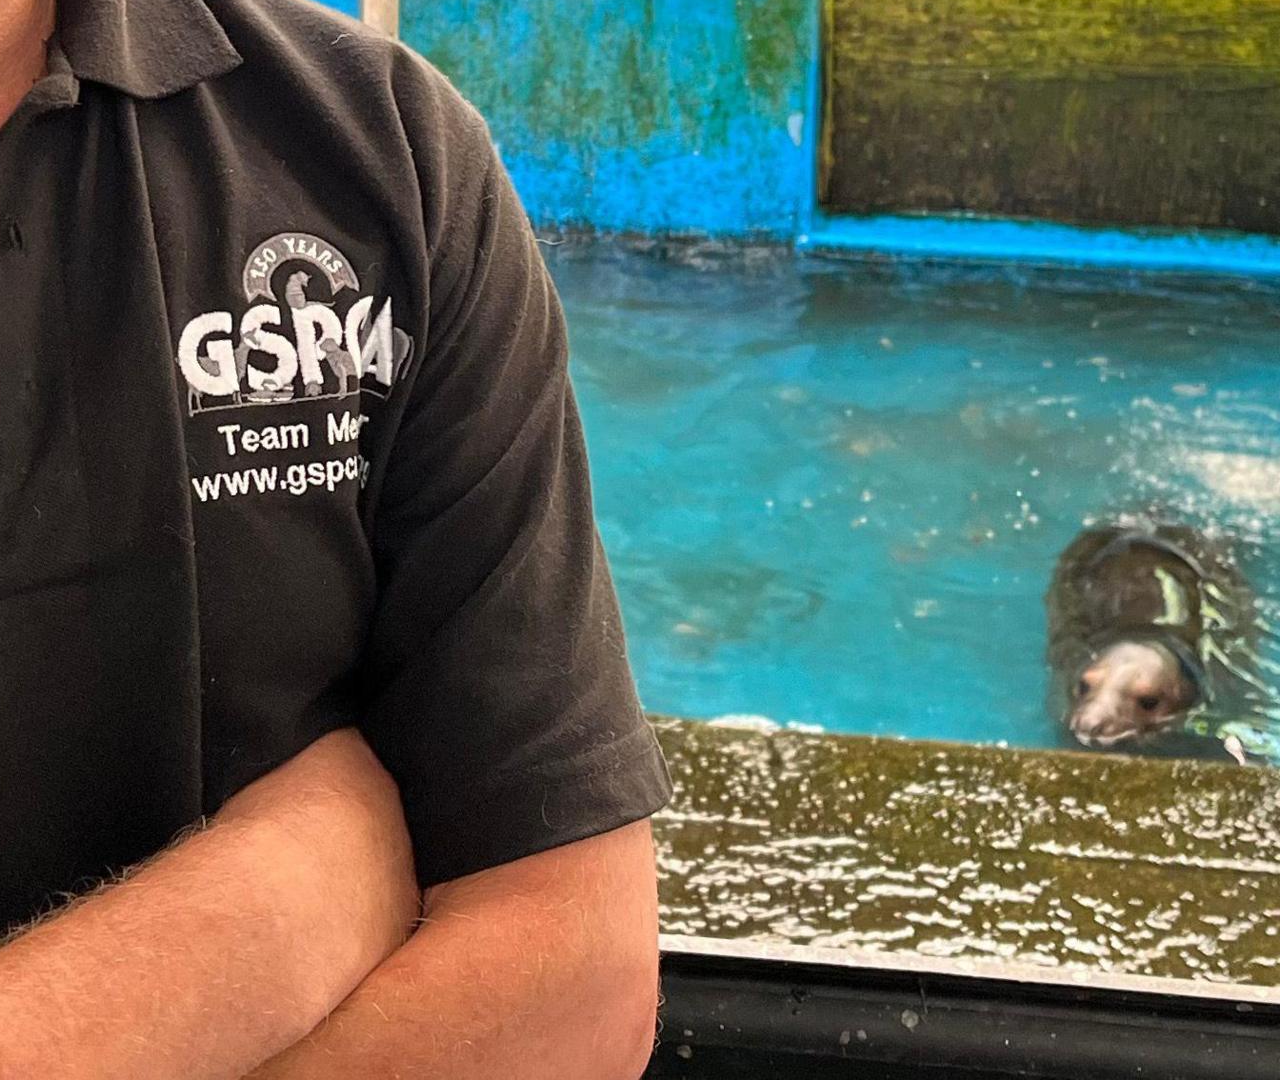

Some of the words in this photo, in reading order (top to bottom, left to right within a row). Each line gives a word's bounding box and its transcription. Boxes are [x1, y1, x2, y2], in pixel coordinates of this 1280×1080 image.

[249, 247, 277, 279] 150
[282, 236, 343, 274] YEARS
[177, 294, 394, 397] GSPCA
[217, 423, 309, 456] Team
